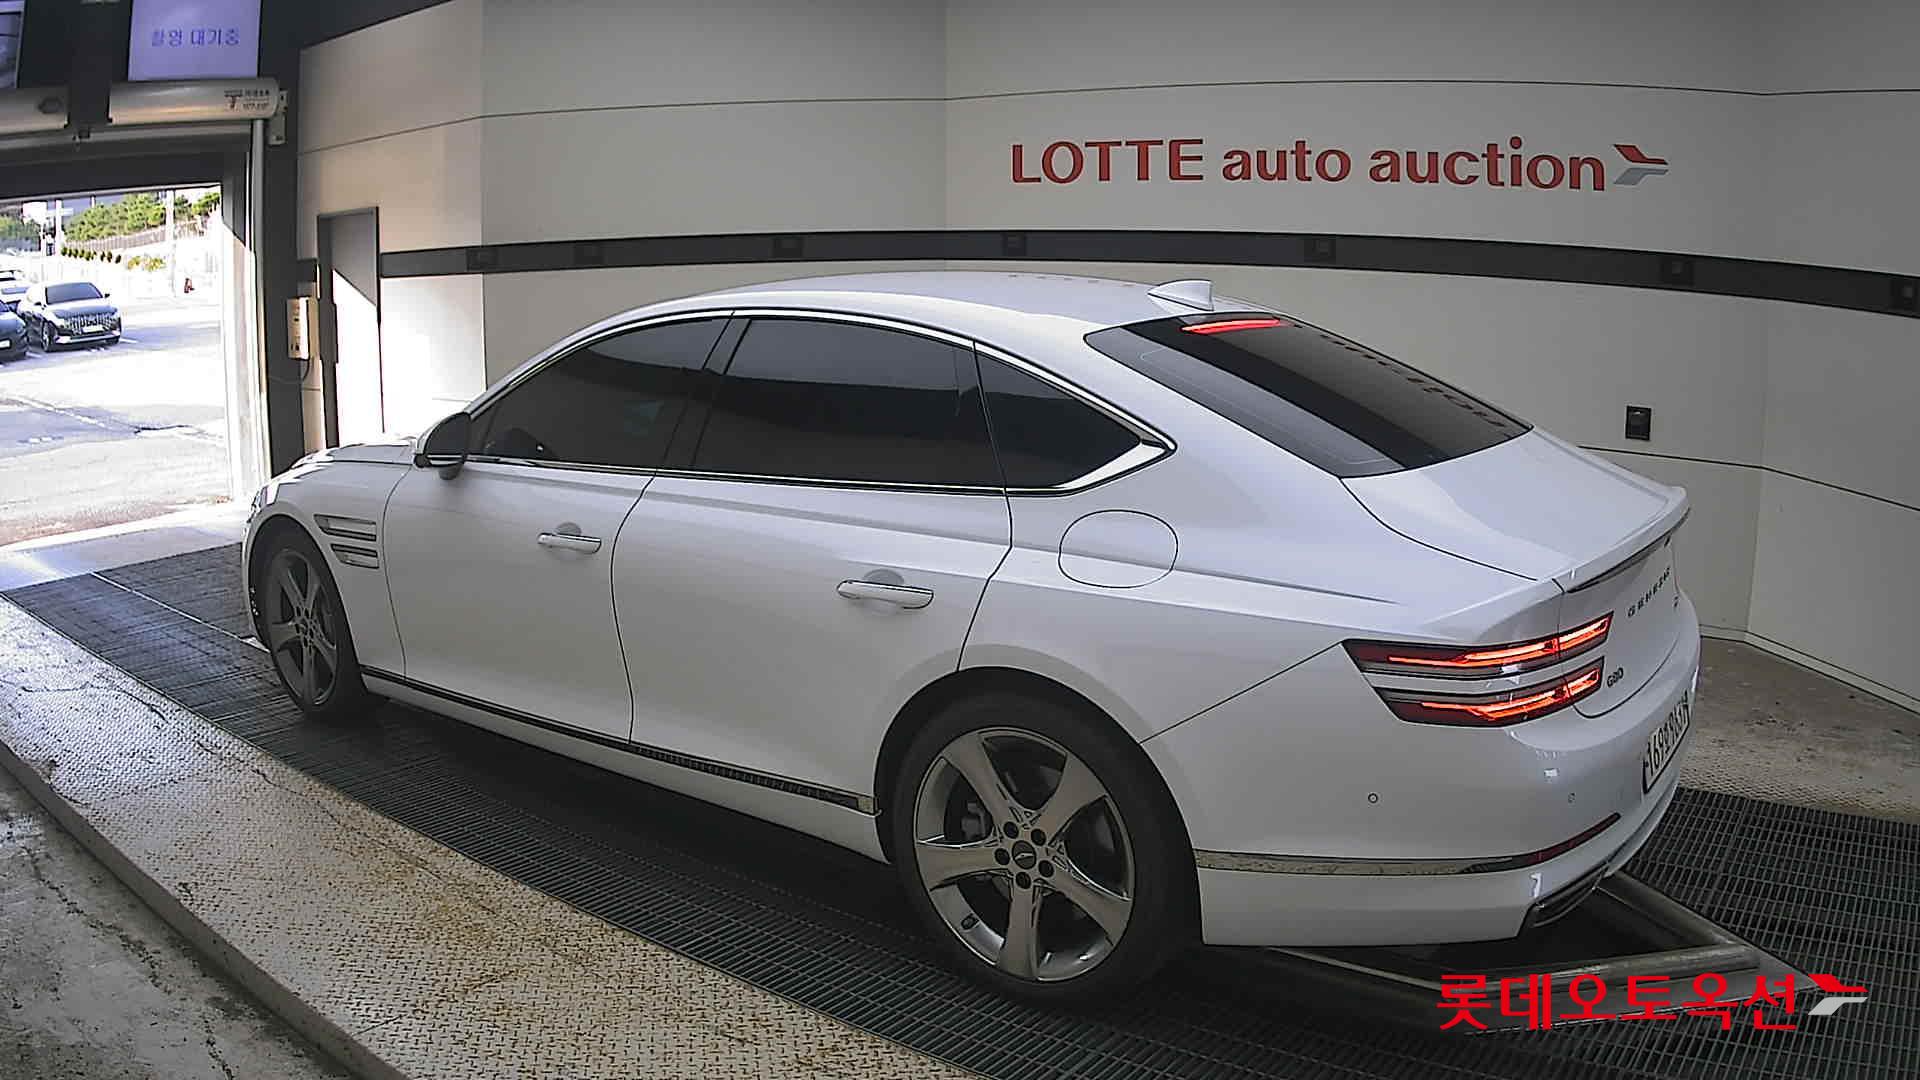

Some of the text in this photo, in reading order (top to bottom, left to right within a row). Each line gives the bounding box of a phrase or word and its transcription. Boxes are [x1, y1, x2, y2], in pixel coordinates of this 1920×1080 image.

[191, 26, 240, 47] 대기중
[1011, 136, 1605, 190] LOTTE auto auction
